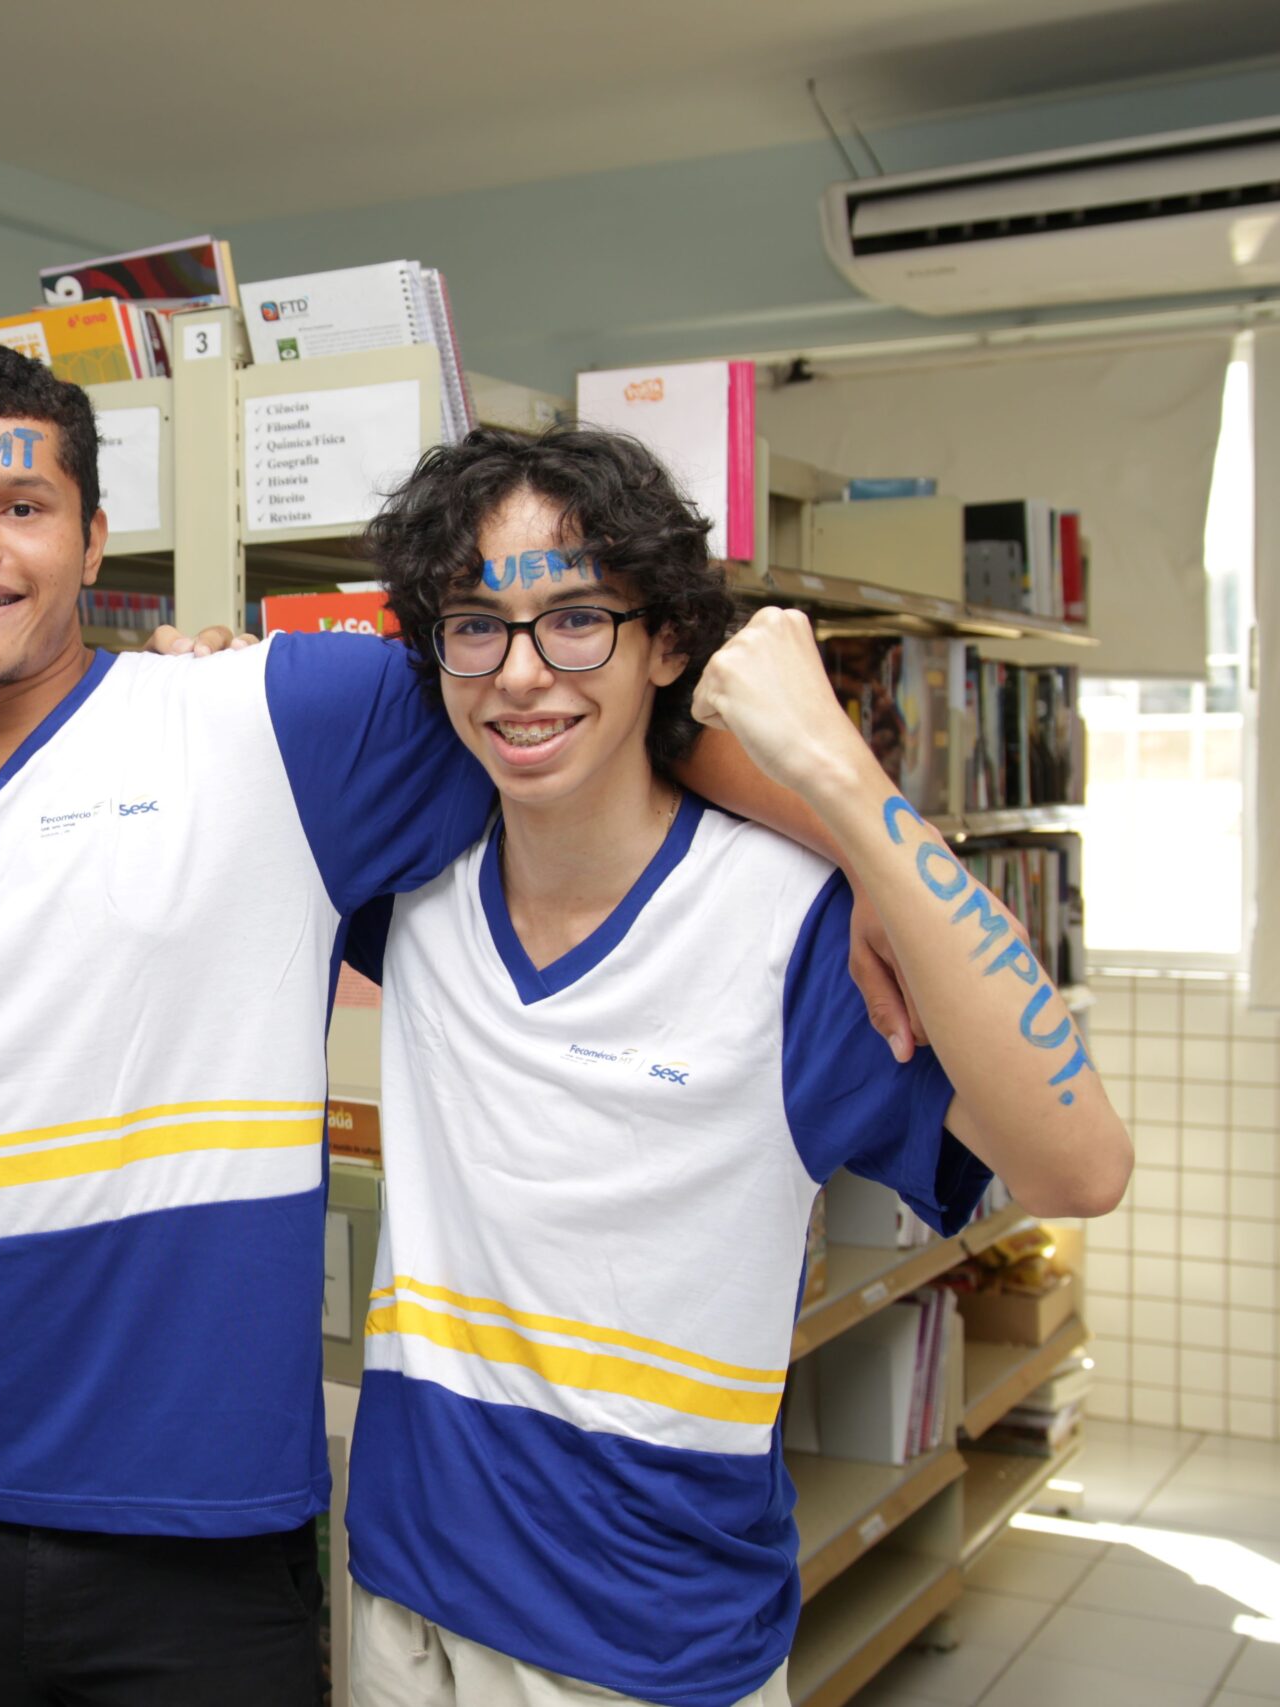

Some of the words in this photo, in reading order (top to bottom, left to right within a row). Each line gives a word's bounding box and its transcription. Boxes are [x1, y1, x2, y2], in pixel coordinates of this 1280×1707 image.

[280, 298, 309, 313] FTD
[195, 331, 209, 354] 3
[266, 402, 310, 416] Ciências
[266, 419, 311, 433] Filosofia
[267, 455, 320, 470] Geografia
[268, 474, 309, 488] História
[269, 492, 306, 506] Direito
[270, 511, 312, 524] Revistas
[40, 811, 92, 825] Fecomércio
[882, 795, 1096, 1107] COMPUT.
[569, 1043, 618, 1062] Fecomércio
